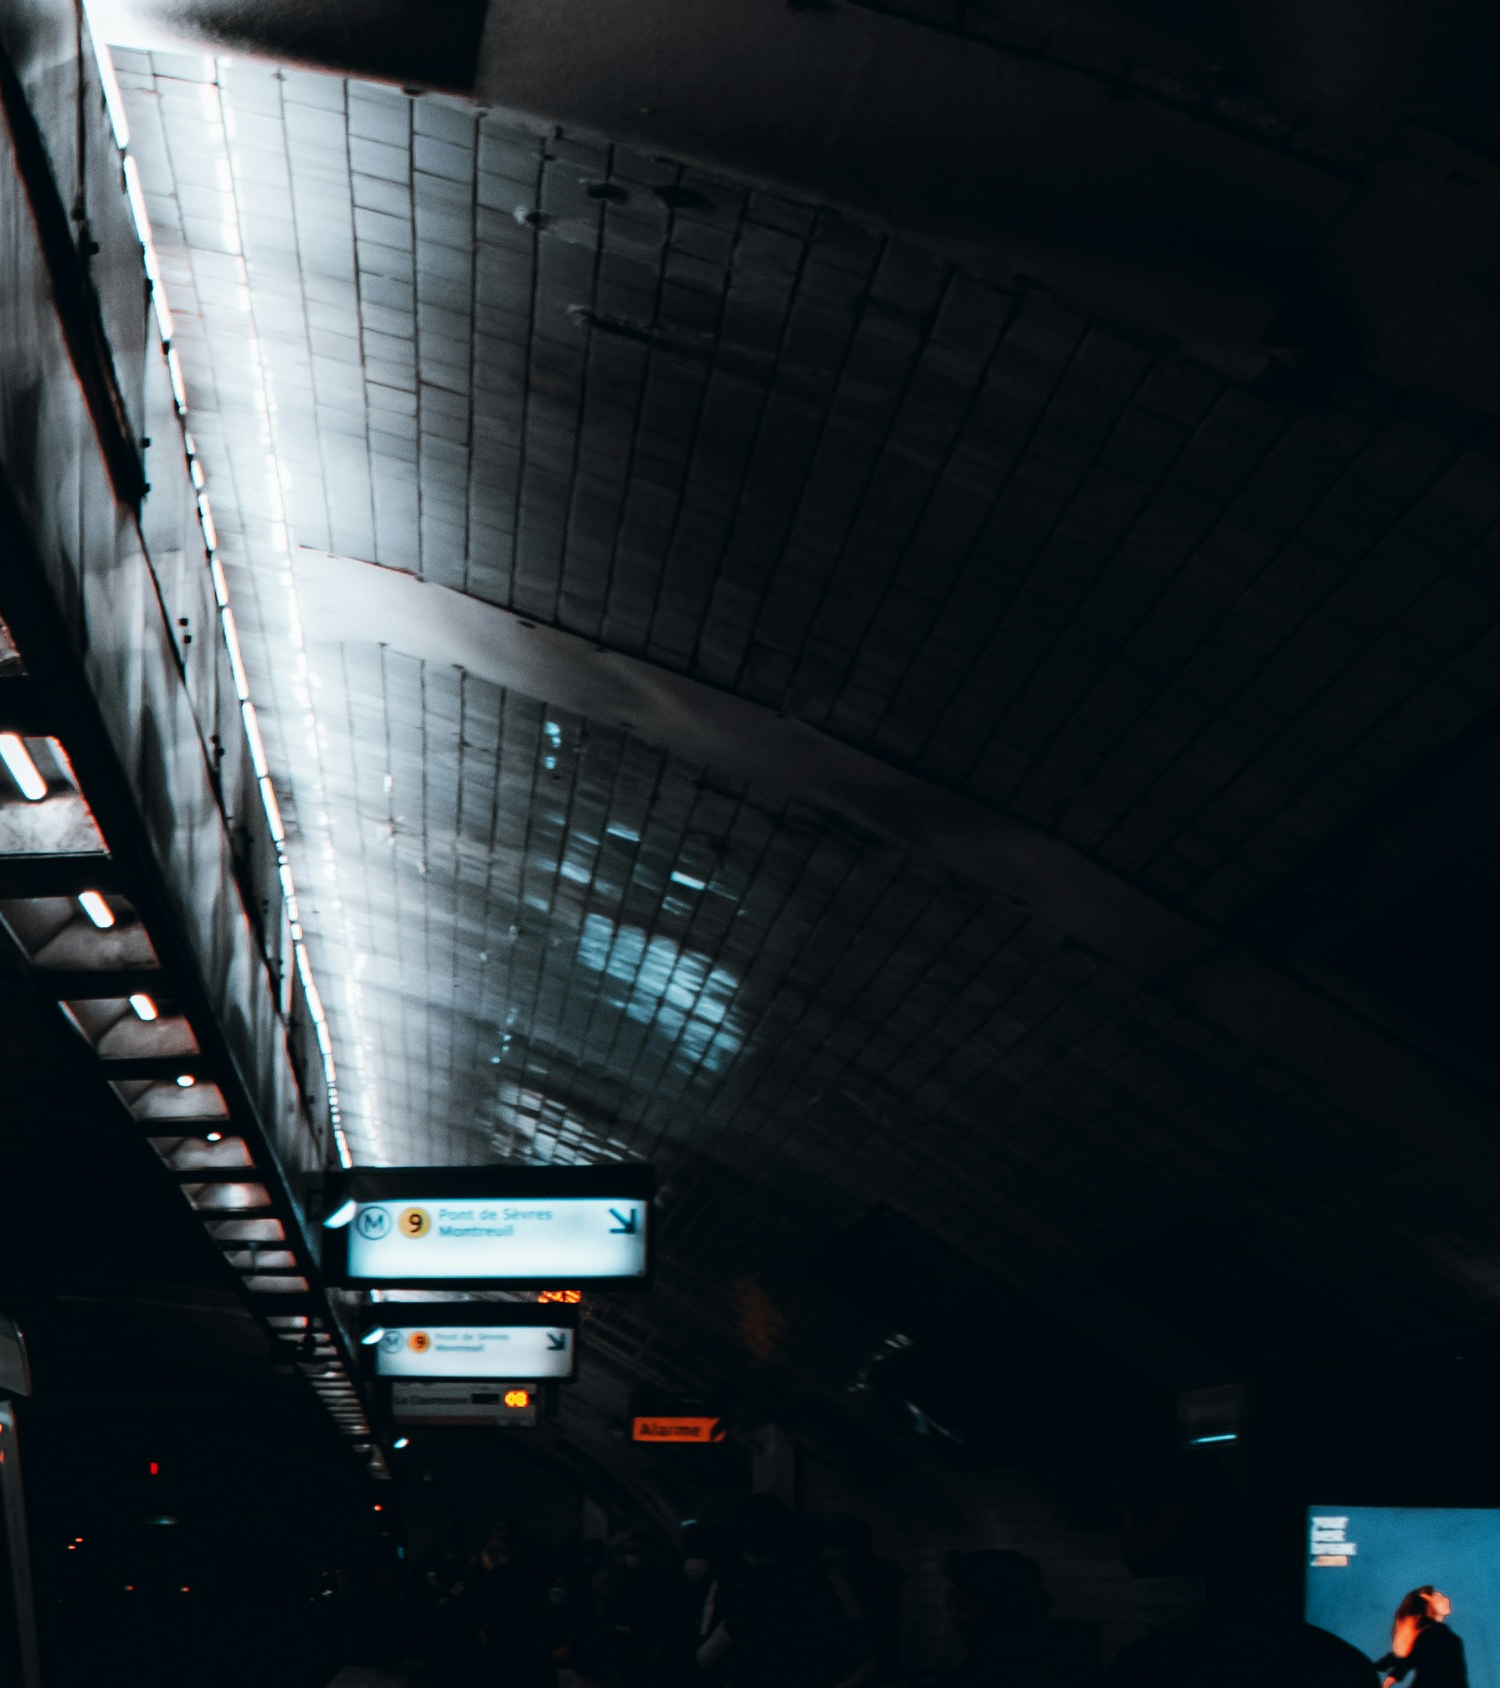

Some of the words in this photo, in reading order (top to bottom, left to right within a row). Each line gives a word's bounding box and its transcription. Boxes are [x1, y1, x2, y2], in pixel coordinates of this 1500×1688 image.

[408, 1213, 423, 1234] 9
[438, 1208, 475, 1221] Pont
[479, 1208, 497, 1221] de
[438, 1225, 514, 1237] Montreuil
[639, 1423, 701, 1437] Alarme
